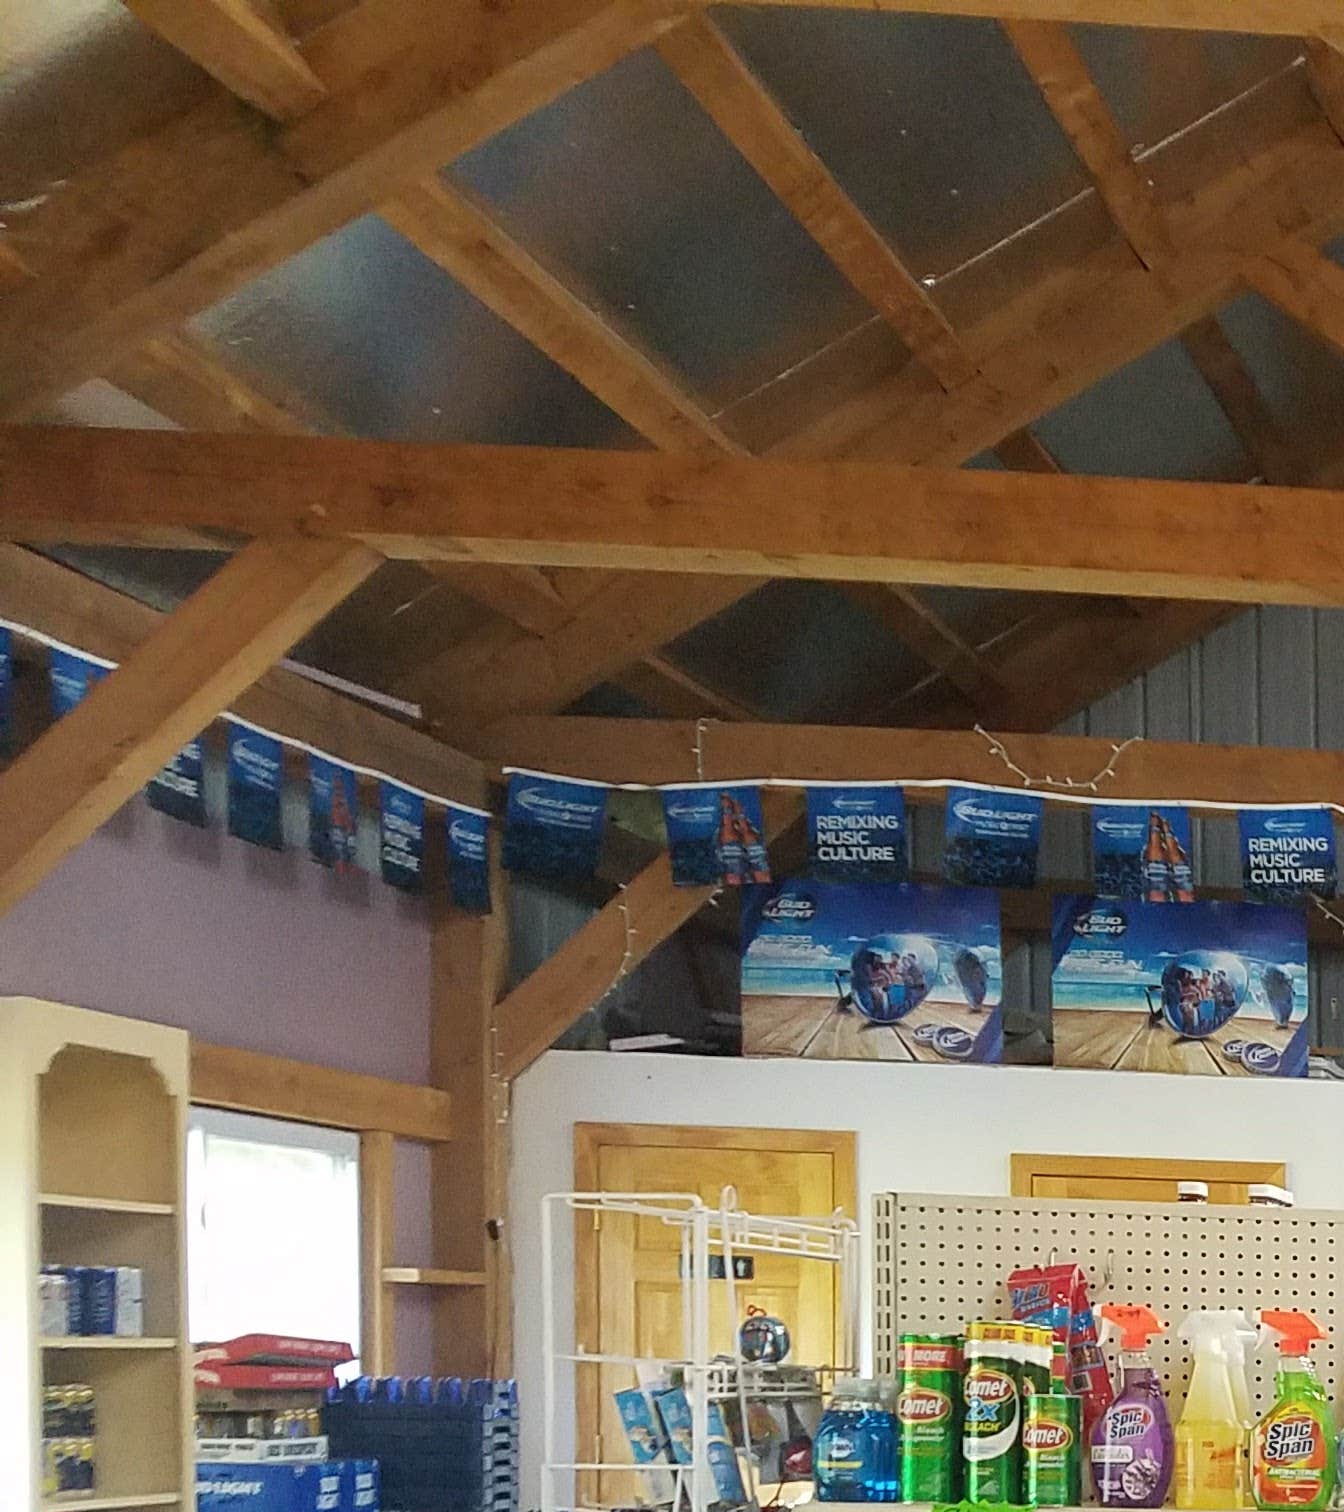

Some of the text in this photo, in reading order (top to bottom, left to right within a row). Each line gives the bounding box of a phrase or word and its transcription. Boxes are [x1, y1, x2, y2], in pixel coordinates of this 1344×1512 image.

[817, 815, 898, 829] REMIXING
[817, 831, 870, 845] MUSIC
[1249, 837, 1328, 851] REMIXING
[818, 846, 895, 861] CULTURE
[1251, 854, 1300, 867] MUSIC
[1251, 869, 1325, 883] CULTURE
[966, 1379, 1008, 1396] Comet
[900, 1399, 942, 1415] Comet
[1112, 1412, 1141, 1426] Spic
[1023, 1428, 1065, 1444] Comet
[1110, 1423, 1144, 1438] Span
[1270, 1422, 1311, 1440] Spic
[1267, 1439, 1313, 1458] Span
